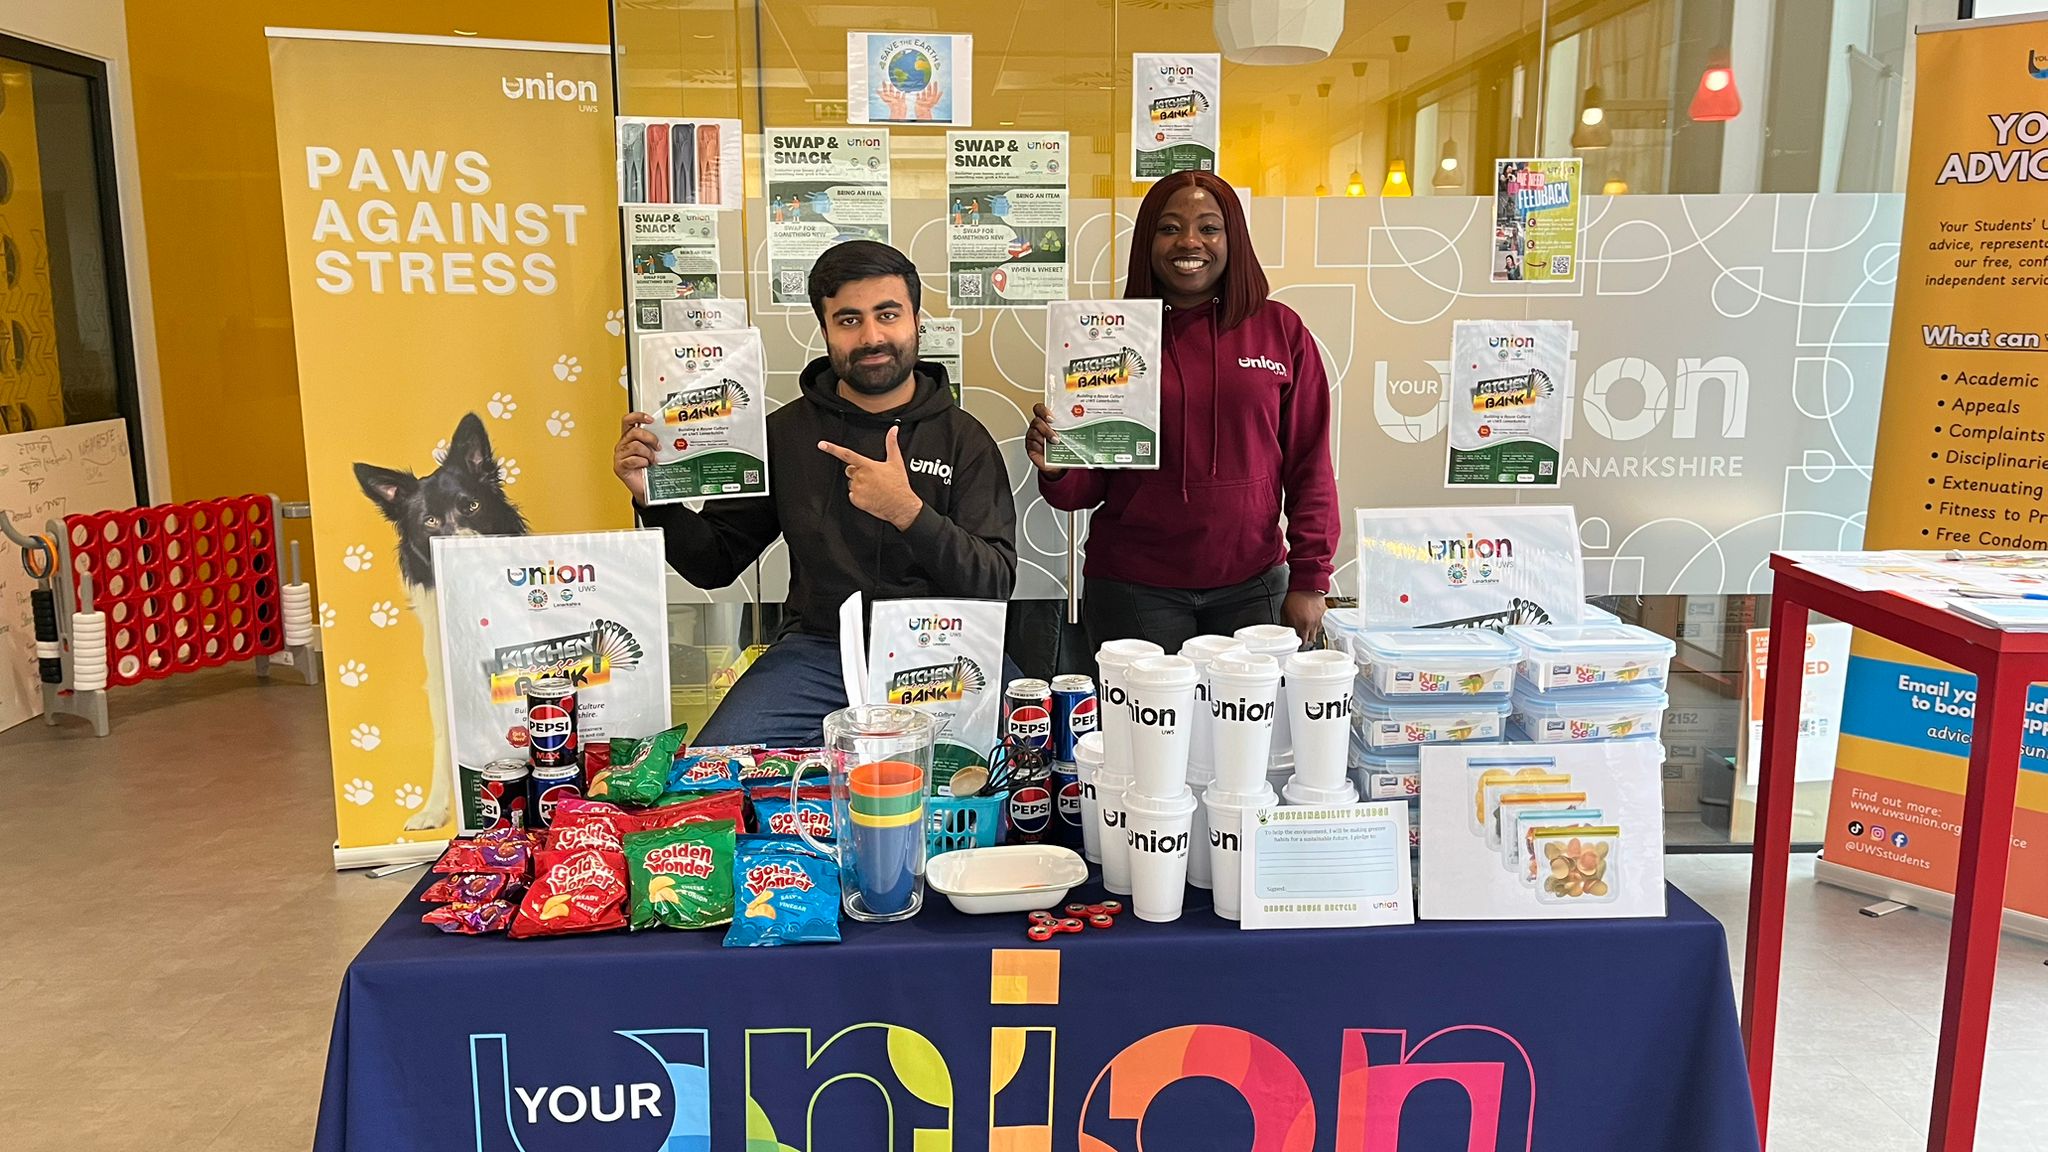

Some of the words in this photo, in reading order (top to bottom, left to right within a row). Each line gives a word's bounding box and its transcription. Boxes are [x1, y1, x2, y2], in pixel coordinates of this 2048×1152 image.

[880, 41, 899, 61] SAVE
[914, 39, 939, 62] EARTH
[578, 105, 599, 113] UWS
[1160, 109, 1189, 120] BANK
[1988, 111, 2048, 146] YO
[773, 136, 825, 149] SWAP
[826, 136, 839, 149] &
[954, 139, 1005, 152] SWAP
[1006, 139, 1019, 152] &
[774, 151, 832, 164] SNACK
[954, 155, 1012, 167] SNACK
[1935, 148, 2048, 185] ADVIC
[305, 146, 492, 194] PAWS
[1518, 182, 1569, 210] FEEDBACK
[311, 199, 588, 245] AGAINST
[634, 213, 671, 223] SWAP
[1940, 221, 1968, 232] Your
[1974, 218, 2036, 232] Students'
[635, 224, 676, 233] SNACK
[1929, 239, 1974, 251] advice,
[1954, 258, 1977, 268] our
[1983, 256, 2012, 269] free,
[315, 250, 559, 295] STRESS
[1925, 274, 2006, 288] independent
[2011, 275, 2048, 286] servic
[1922, 325, 1991, 347] What
[1995, 333, 2040, 348] can
[1072, 355, 1120, 373] KITCHEN
[1078, 373, 1118, 388] BANK
[1388, 380, 1438, 395] YOUR
[1479, 376, 1529, 394] KITCHEN
[1955, 371, 2040, 388] Academic
[669, 387, 722, 407] KITCHEN
[1485, 394, 1525, 409] BANK
[678, 406, 720, 422] BANK
[1951, 398, 2020, 416] Appeals
[1949, 424, 2046, 443] Complaints
[910, 458, 953, 478] unio
[1561, 456, 1744, 479] ANARKSHIRE
[1945, 450, 2048, 470] Disciplinarie
[1943, 476, 2044, 501] Extenuating
[1939, 501, 1996, 519] Fitness
[2004, 508, 2020, 521] to
[1936, 527, 1971, 543] Free
[1979, 531, 2048, 551] Condom
[501, 637, 594, 670] KITCHEN
[897, 665, 954, 687] KITCHEN
[1419, 671, 1445, 682] Klip
[1577, 671, 1605, 683] Seal
[901, 686, 949, 705] BANK
[1420, 681, 1449, 692] Seal
[1898, 674, 1950, 698] Email
[1953, 688, 1977, 704] yo
[578, 703, 605, 711] Culture
[1305, 693, 1354, 720] uni
[1912, 695, 1930, 710] to
[1072, 714, 1096, 726] PEP
[1127, 700, 1176, 727] nion
[1668, 712, 1698, 725] 2152
[530, 720, 569, 733] PEPSI
[1010, 722, 1049, 734] PEPSI
[1407, 730, 1436, 741] Seal
[1571, 726, 1599, 738] Seal
[1927, 726, 1972, 744] advic
[536, 751, 560, 759] MAX
[481, 803, 497, 815] PSI
[1012, 803, 1050, 815] PEPSI
[1851, 787, 1877, 802] Find
[1882, 795, 1902, 808] out
[1907, 801, 1942, 818] more:
[771, 810, 830, 833] Goden
[1273, 810, 1351, 820] SUSTAINABILITY
[1355, 808, 1389, 817] PLEDGE
[646, 843, 712, 864] Golden
[1845, 841, 1931, 870] @UWSstudents
[645, 860, 714, 878] Wonder
[549, 870, 616, 895] Wonder
[747, 876, 814, 896] Wonder
[779, 902, 807, 912] VINEGAR
[515, 1083, 663, 1123] YOUR
